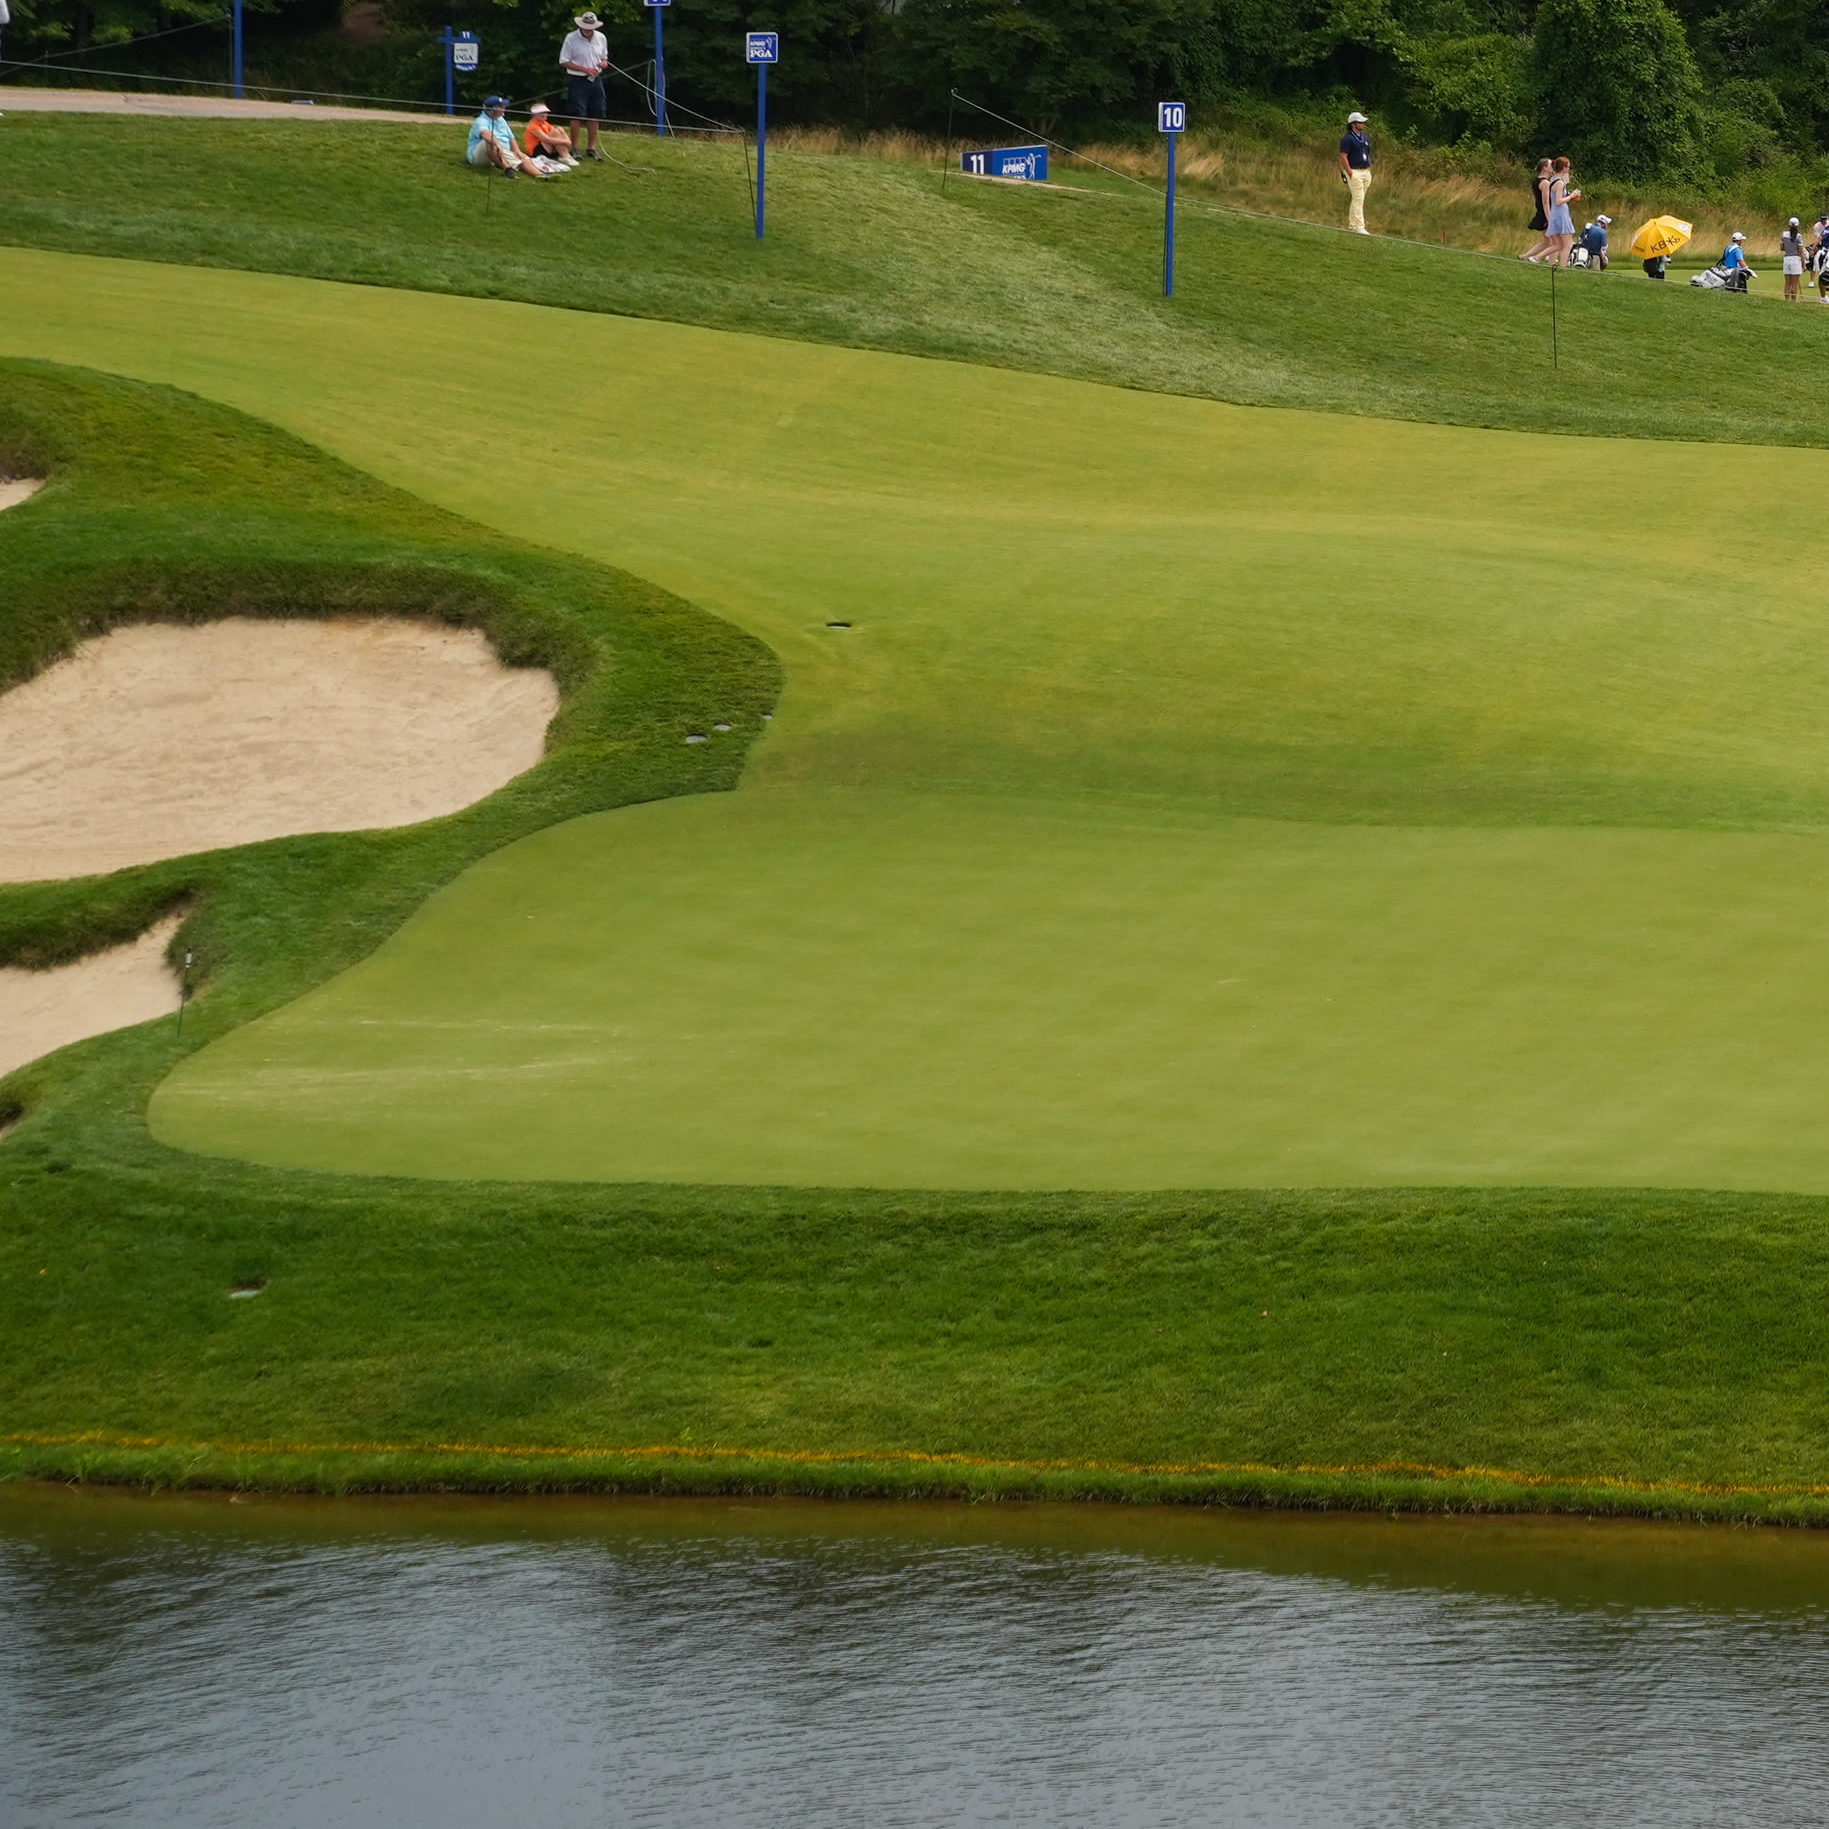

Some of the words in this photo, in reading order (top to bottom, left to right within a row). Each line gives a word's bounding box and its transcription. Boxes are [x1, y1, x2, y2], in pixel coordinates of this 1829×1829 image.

[750, 49, 773, 58] PGA
[1164, 107, 1182, 128] 10
[970, 154, 985, 175] 11
[1002, 162, 1027, 174] KPMG
